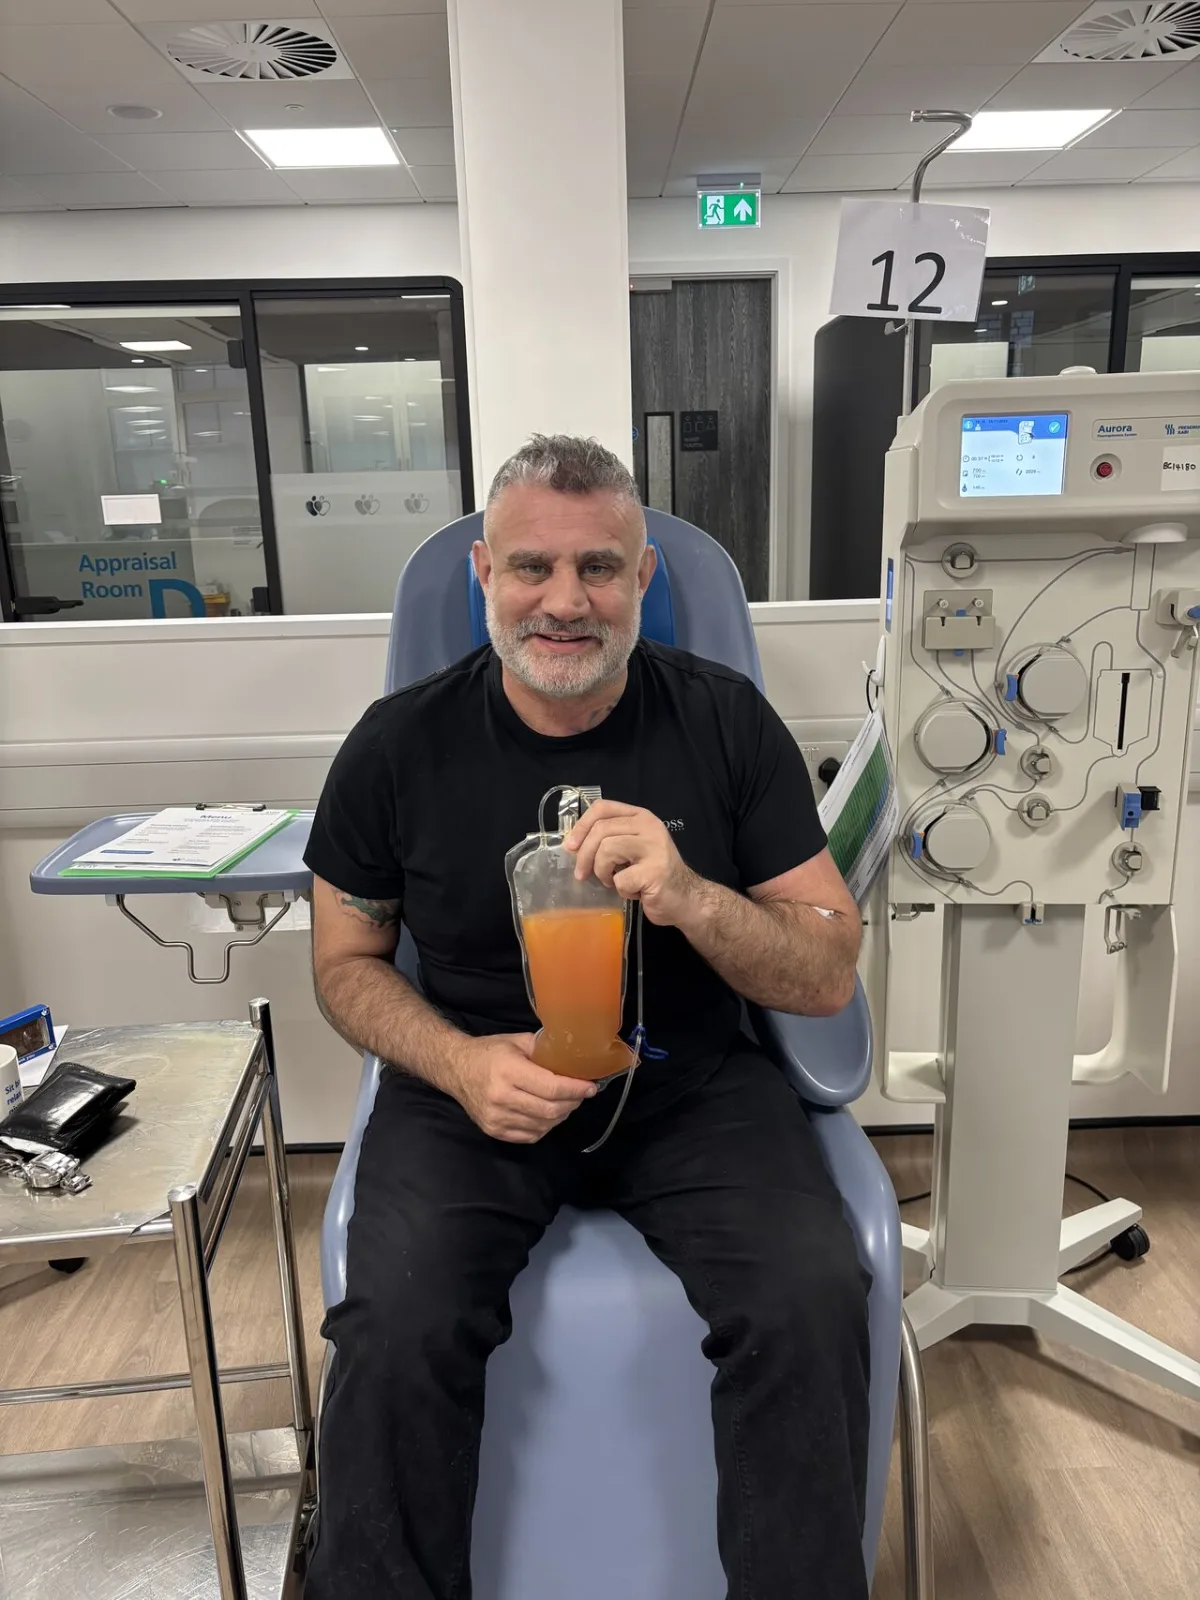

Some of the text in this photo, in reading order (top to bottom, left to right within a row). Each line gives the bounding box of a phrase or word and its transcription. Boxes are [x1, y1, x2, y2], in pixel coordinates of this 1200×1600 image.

[866, 250, 946, 314] 12
[1097, 425, 1132, 433] Aurora
[1163, 462, 1196, 471] BC14180
[79, 551, 177, 576] Appraisal
[82, 581, 143, 598] Room
[664, 819, 684, 828] OSS
[5, 1084, 15, 1095] Sit
